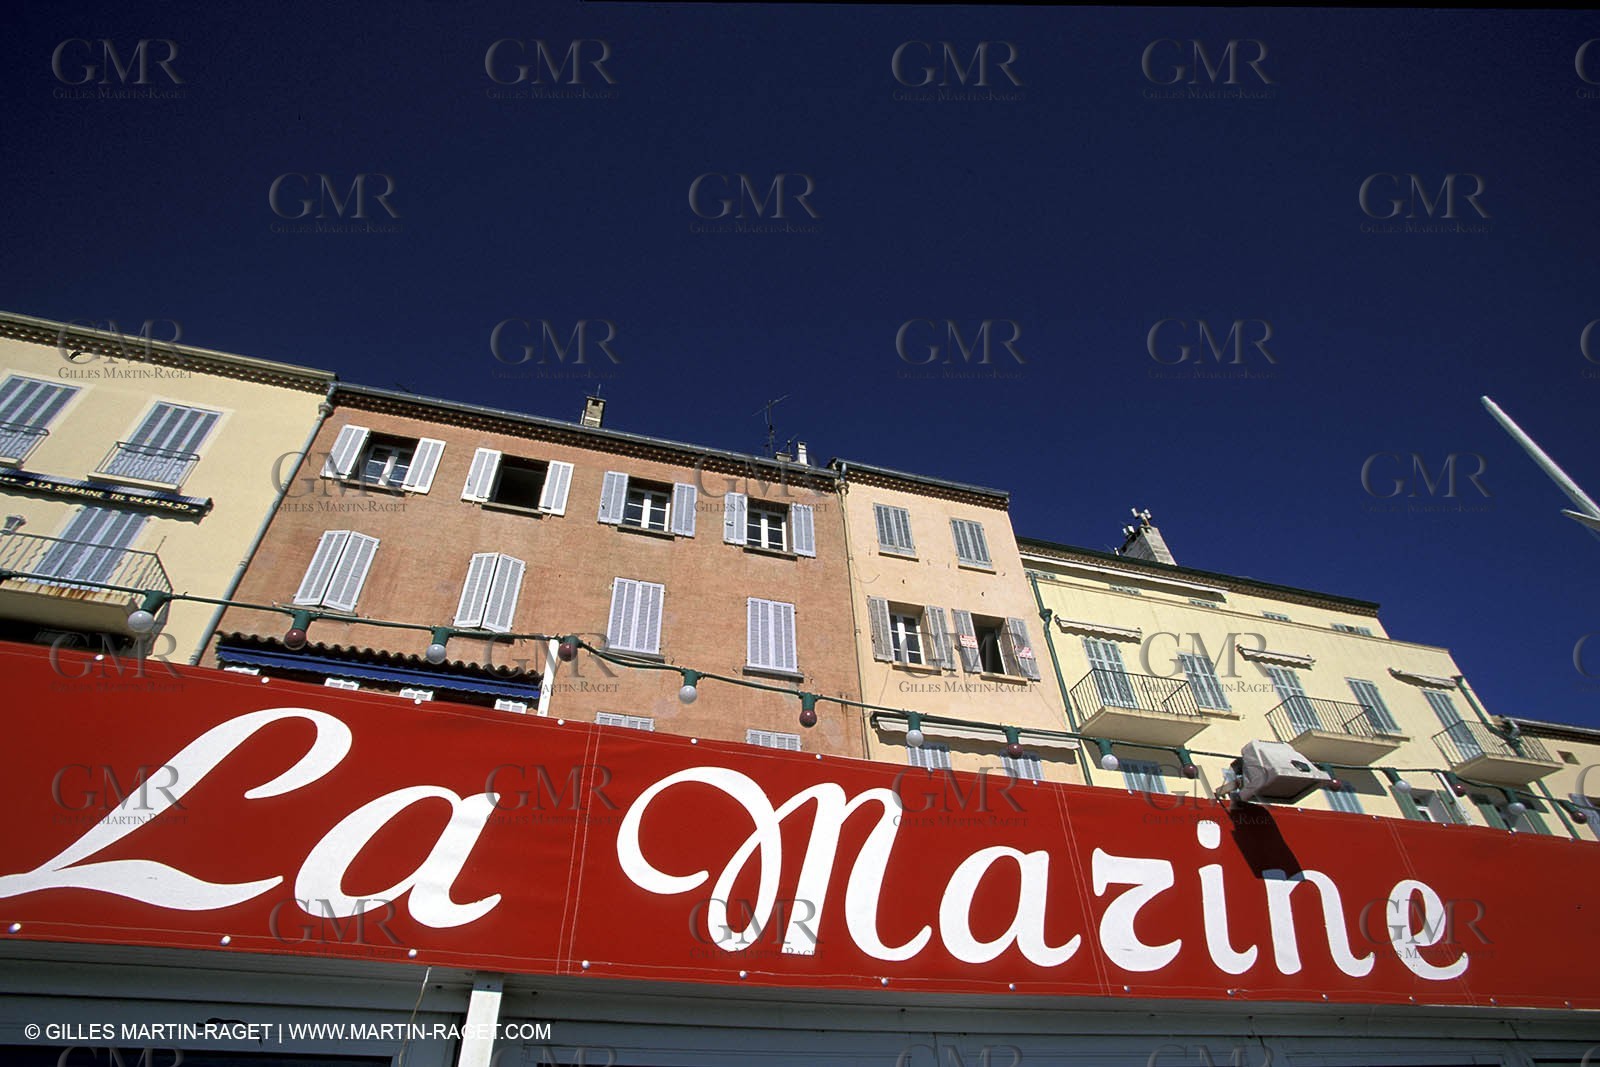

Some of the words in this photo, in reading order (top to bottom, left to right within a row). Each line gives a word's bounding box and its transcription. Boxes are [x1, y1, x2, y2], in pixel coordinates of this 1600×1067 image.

[38, 482, 52, 490] LA
[55, 485, 105, 498] SEMAINE
[110, 493, 126, 501] TEL
[0, 708, 501, 928] La
[617, 767, 1469, 980] Marine
